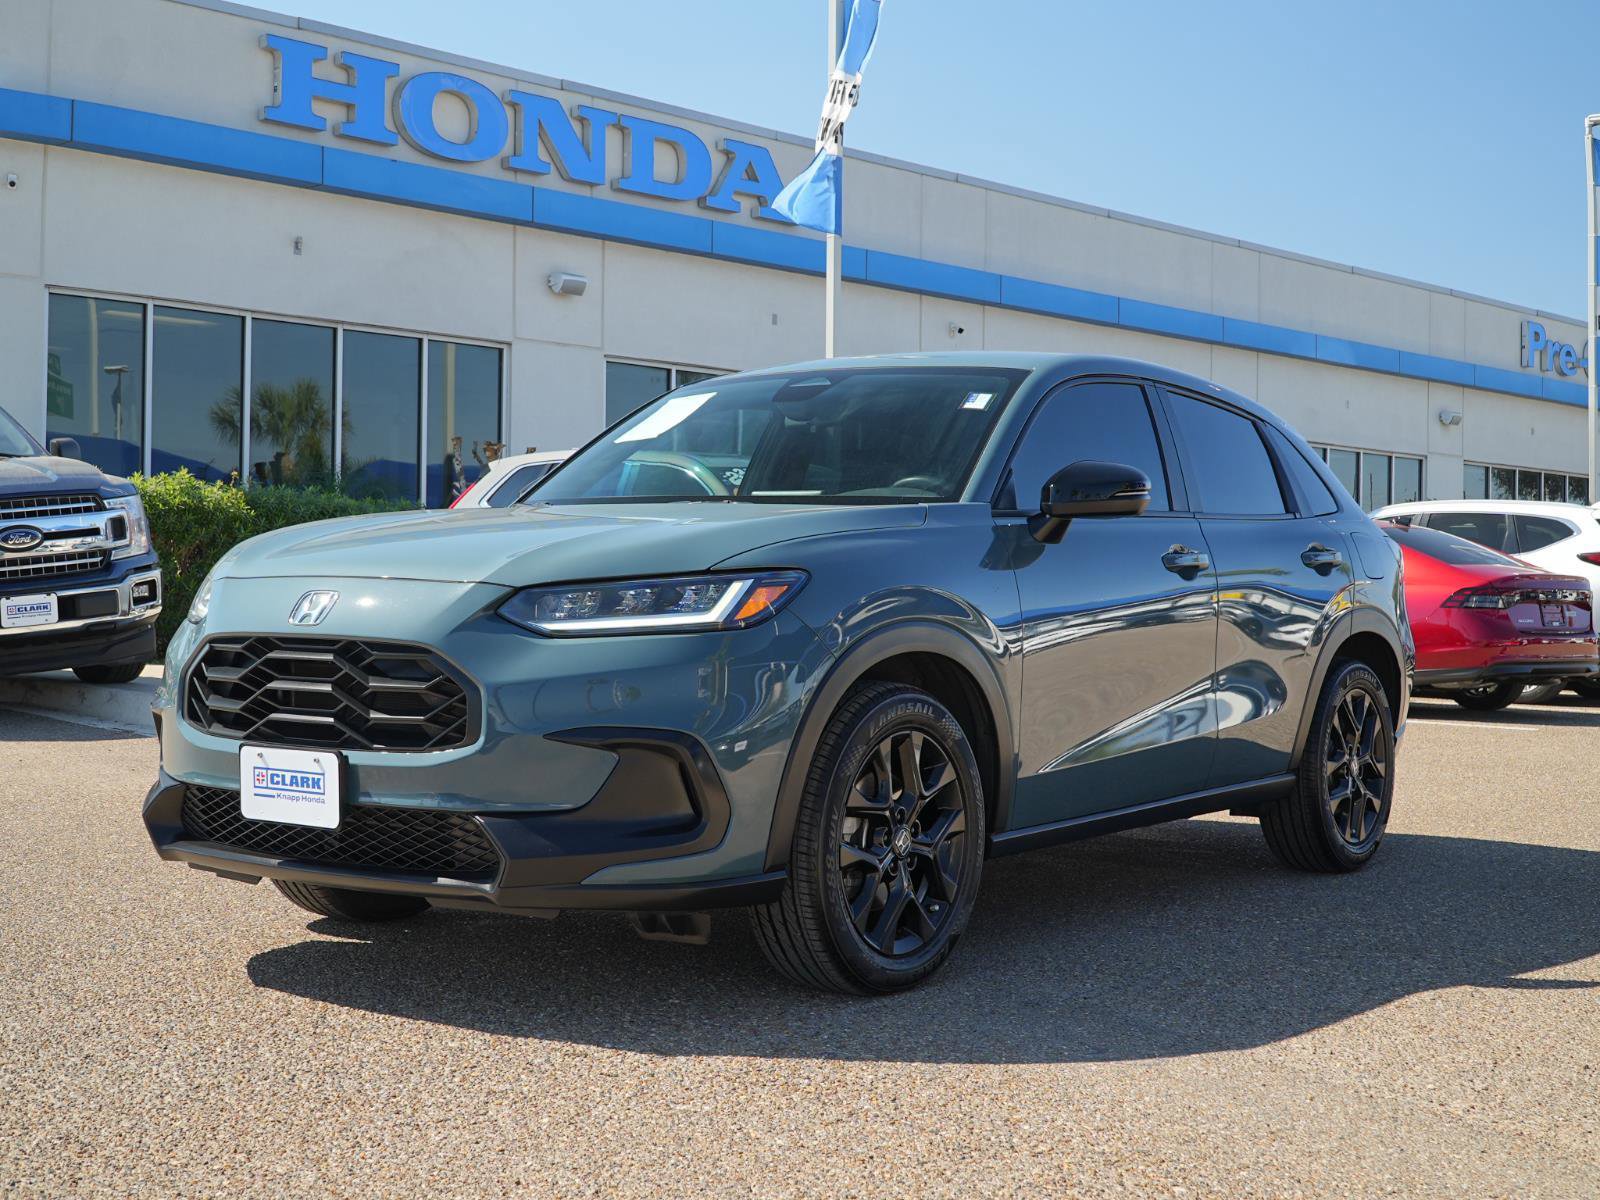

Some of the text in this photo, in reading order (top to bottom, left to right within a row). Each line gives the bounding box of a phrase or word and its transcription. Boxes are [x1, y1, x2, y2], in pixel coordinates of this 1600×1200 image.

[261, 34, 799, 226] HONDA
[1521, 320, 1588, 378] Pre-
[8, 532, 32, 544] Ford
[17, 605, 49, 613] CLARK
[269, 773, 321, 789] CLARK
[276, 793, 326, 804] Knapp Honda
